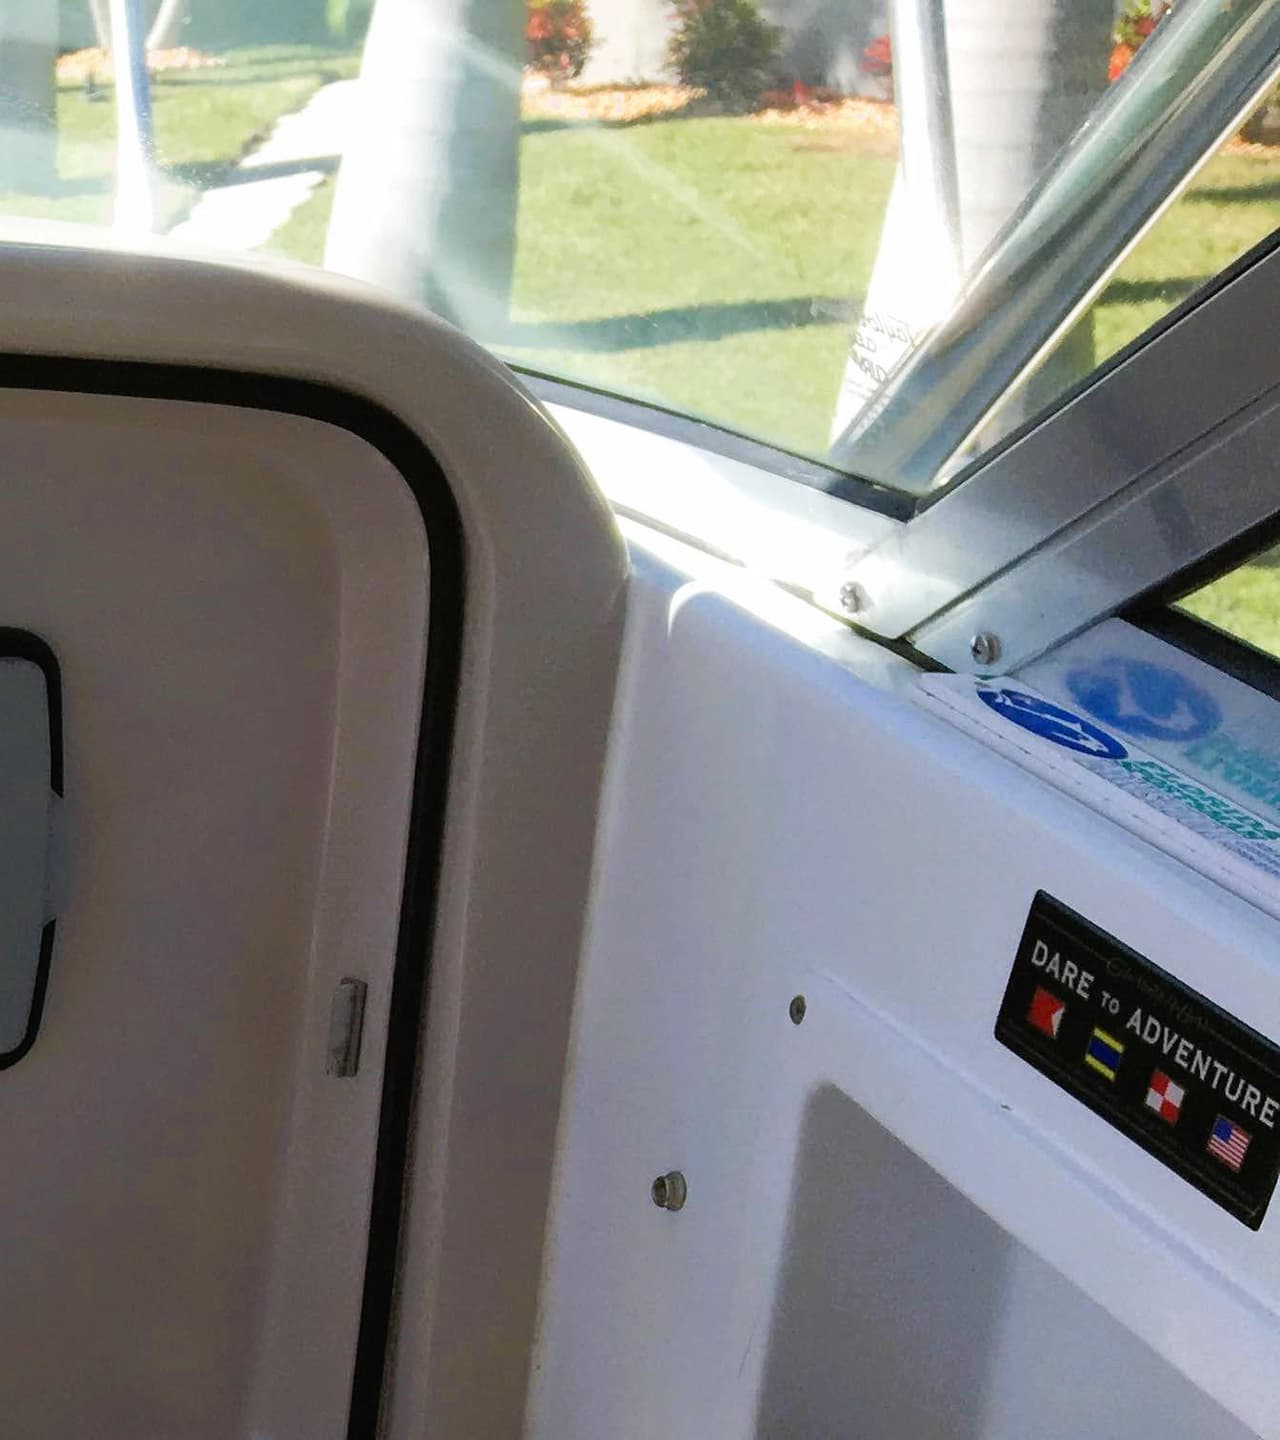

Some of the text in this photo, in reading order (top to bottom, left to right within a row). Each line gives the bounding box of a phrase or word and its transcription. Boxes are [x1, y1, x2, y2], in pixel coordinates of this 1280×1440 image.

[1030, 939, 1095, 1000] DARE
[1100, 989, 1121, 1016] TO
[1125, 1007, 1280, 1129] ADVENTURE
